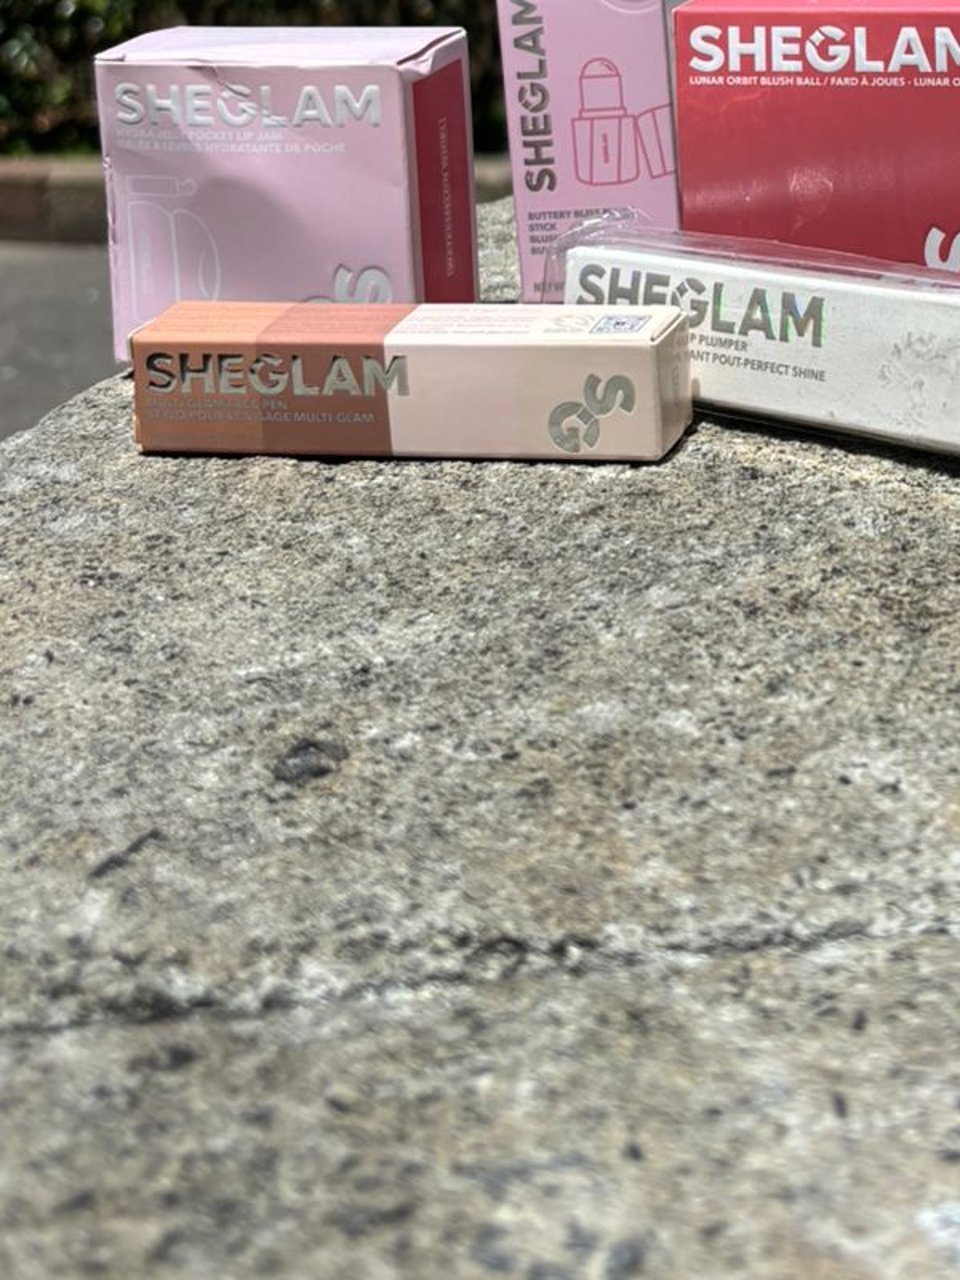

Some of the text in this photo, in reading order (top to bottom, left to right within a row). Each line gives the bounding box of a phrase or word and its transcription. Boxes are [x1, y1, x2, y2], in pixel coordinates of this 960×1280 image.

[689, 76, 724, 86] LUNAR
[726, 76, 758, 86] ORBIT
[760, 76, 794, 86] BLUSH
[796, 76, 821, 86] BALL
[830, 77, 858, 87] FARD
[871, 77, 905, 87] JOUES
[914, 77, 950, 87] LUNAR
[115, 82, 382, 128] SHEGLAM
[528, 209, 571, 221] BUTTERY
[528, 223, 557, 232] STICK
[577, 264, 827, 347] SHEGLAM
[699, 334, 749, 353] PLUMPER
[145, 352, 410, 397] SHEGLAM
[792, 366, 827, 382] SHINE
